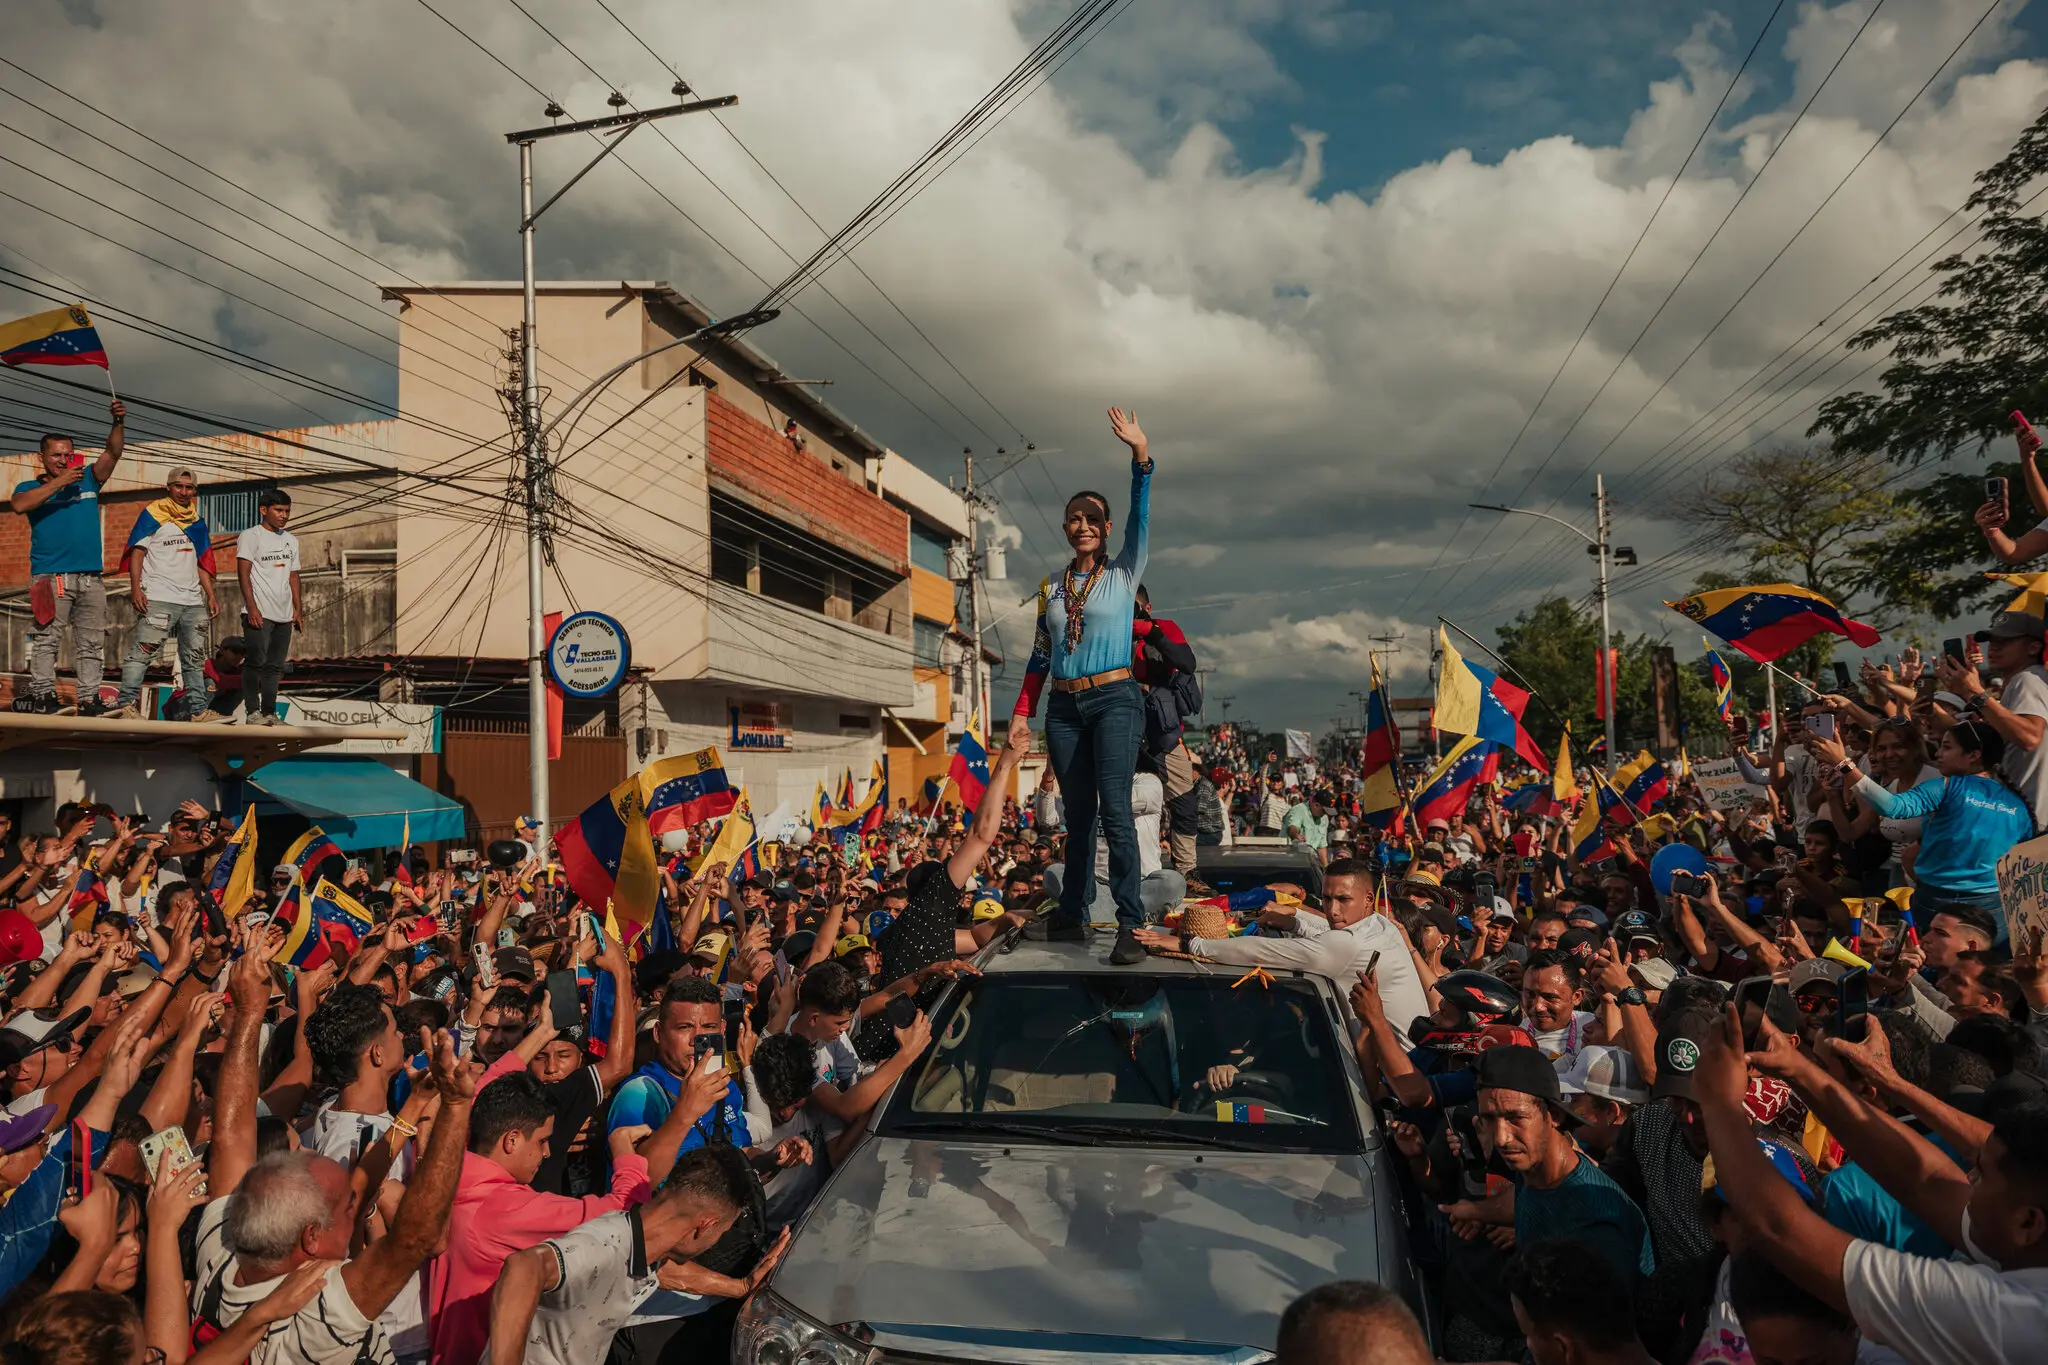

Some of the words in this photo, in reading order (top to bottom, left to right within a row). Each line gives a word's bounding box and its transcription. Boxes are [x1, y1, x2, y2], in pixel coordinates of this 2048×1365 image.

[558, 618, 587, 641] SERVICIO
[575, 655, 617, 664] VALLADARES
[568, 676, 609, 691] ACCESORIOS
[302, 709, 349, 723] TECNO
[350, 712, 381, 724] CELL
